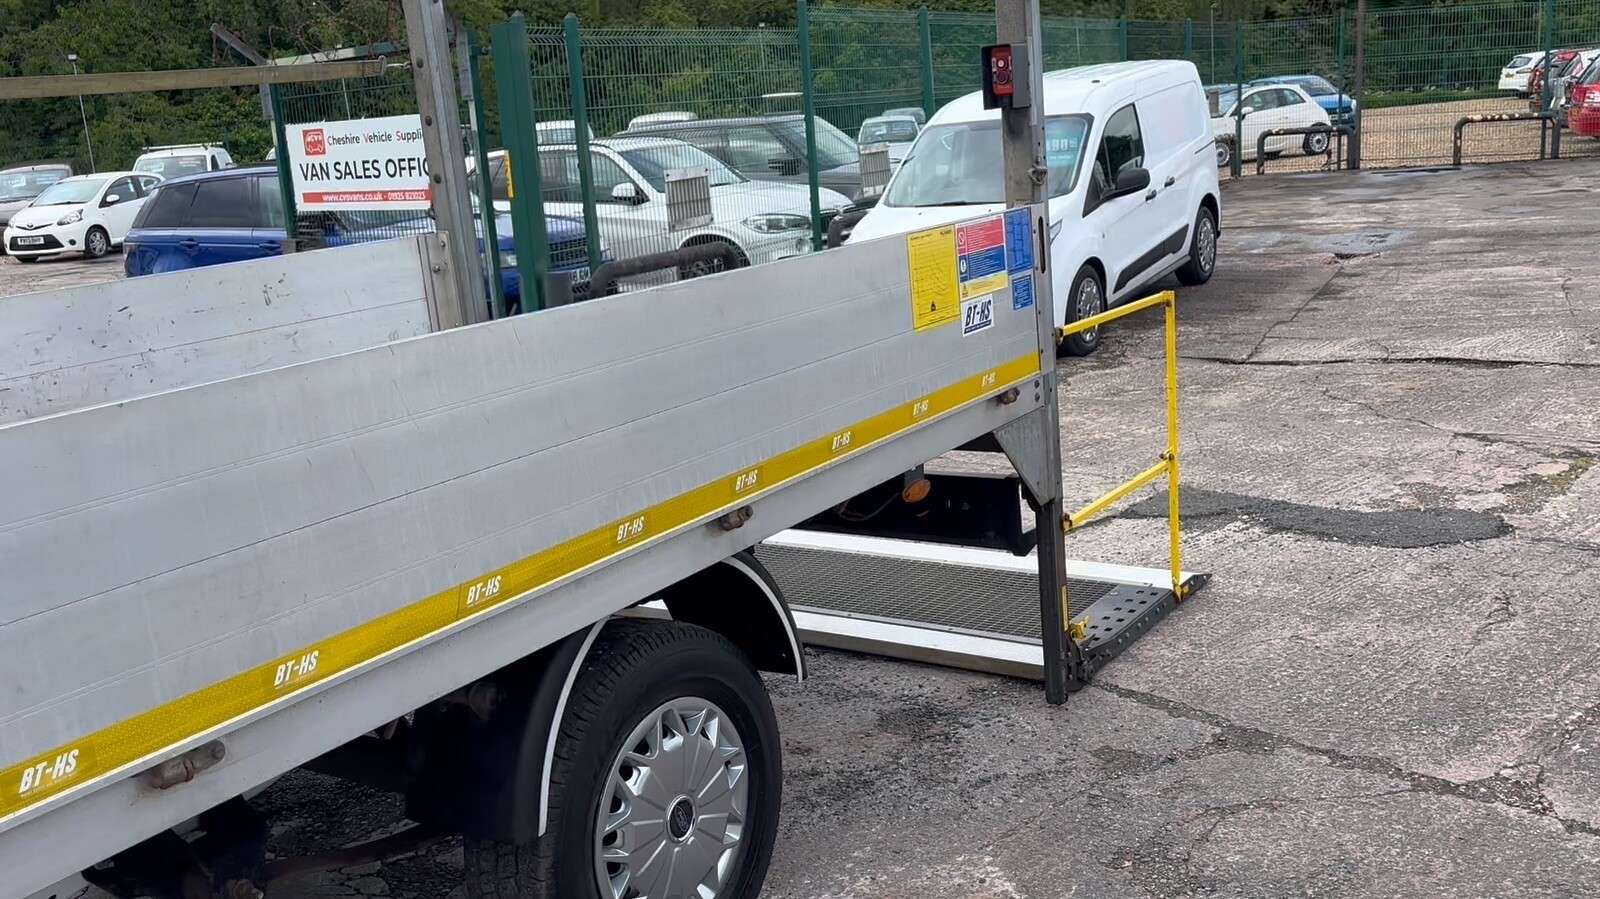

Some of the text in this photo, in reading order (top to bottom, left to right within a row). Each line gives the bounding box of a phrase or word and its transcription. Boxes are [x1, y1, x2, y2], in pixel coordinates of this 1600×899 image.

[327, 128, 422, 146] Cheshire Vehicle Suppli
[299, 156, 430, 181] VAN SALES OFFIC
[965, 299, 992, 327] BT-HS
[831, 430, 851, 450] BT-HS
[736, 469, 758, 491] BT-HS
[616, 515, 645, 541] BT-HS
[466, 575, 502, 605] BT-HS
[273, 650, 319, 686] BT-HS
[18, 748, 79, 794] BT-HS
